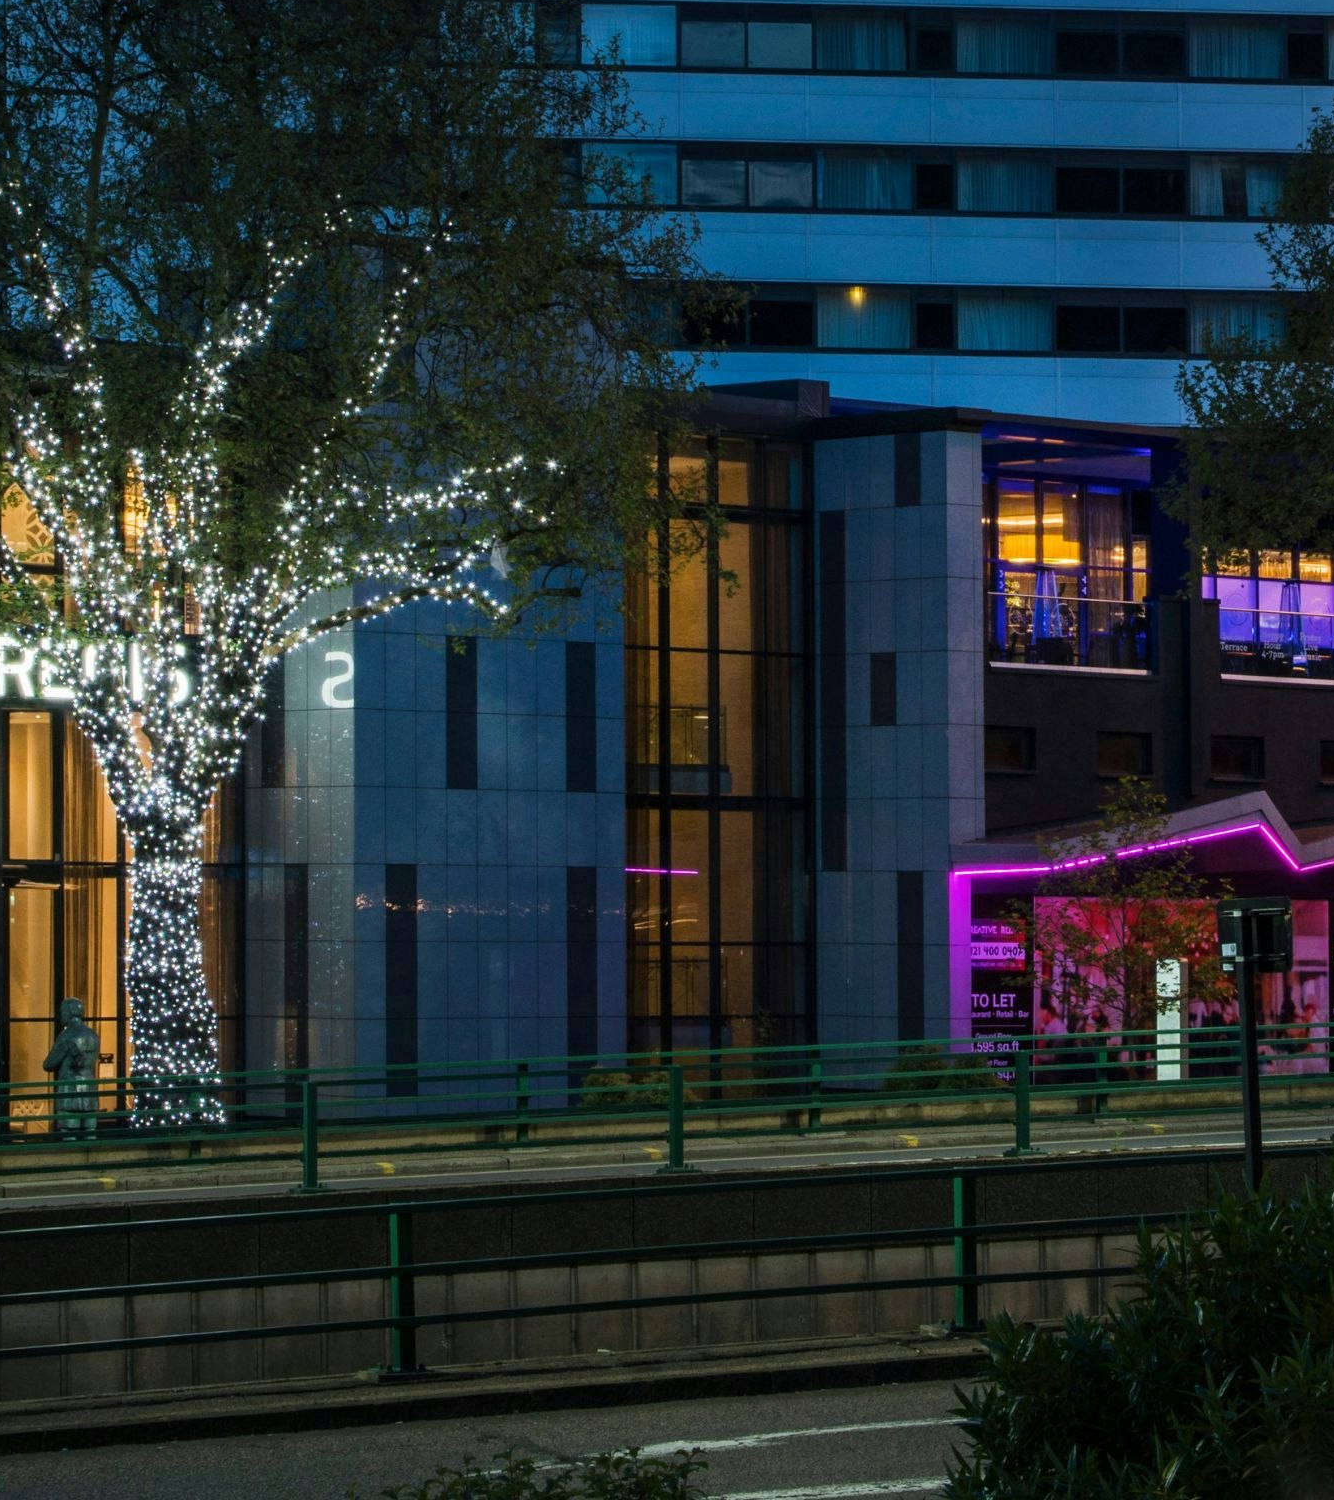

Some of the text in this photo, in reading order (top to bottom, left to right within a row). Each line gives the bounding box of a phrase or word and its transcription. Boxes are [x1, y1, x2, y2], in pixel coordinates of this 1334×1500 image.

[1220, 642, 1248, 651] Terrace
[1301, 652, 1322, 661] Music
[971, 925, 997, 934] REATIVE
[983, 946, 999, 956] 400
[971, 993, 1016, 1008] TO LET
[996, 1010, 1014, 1018] Retail
